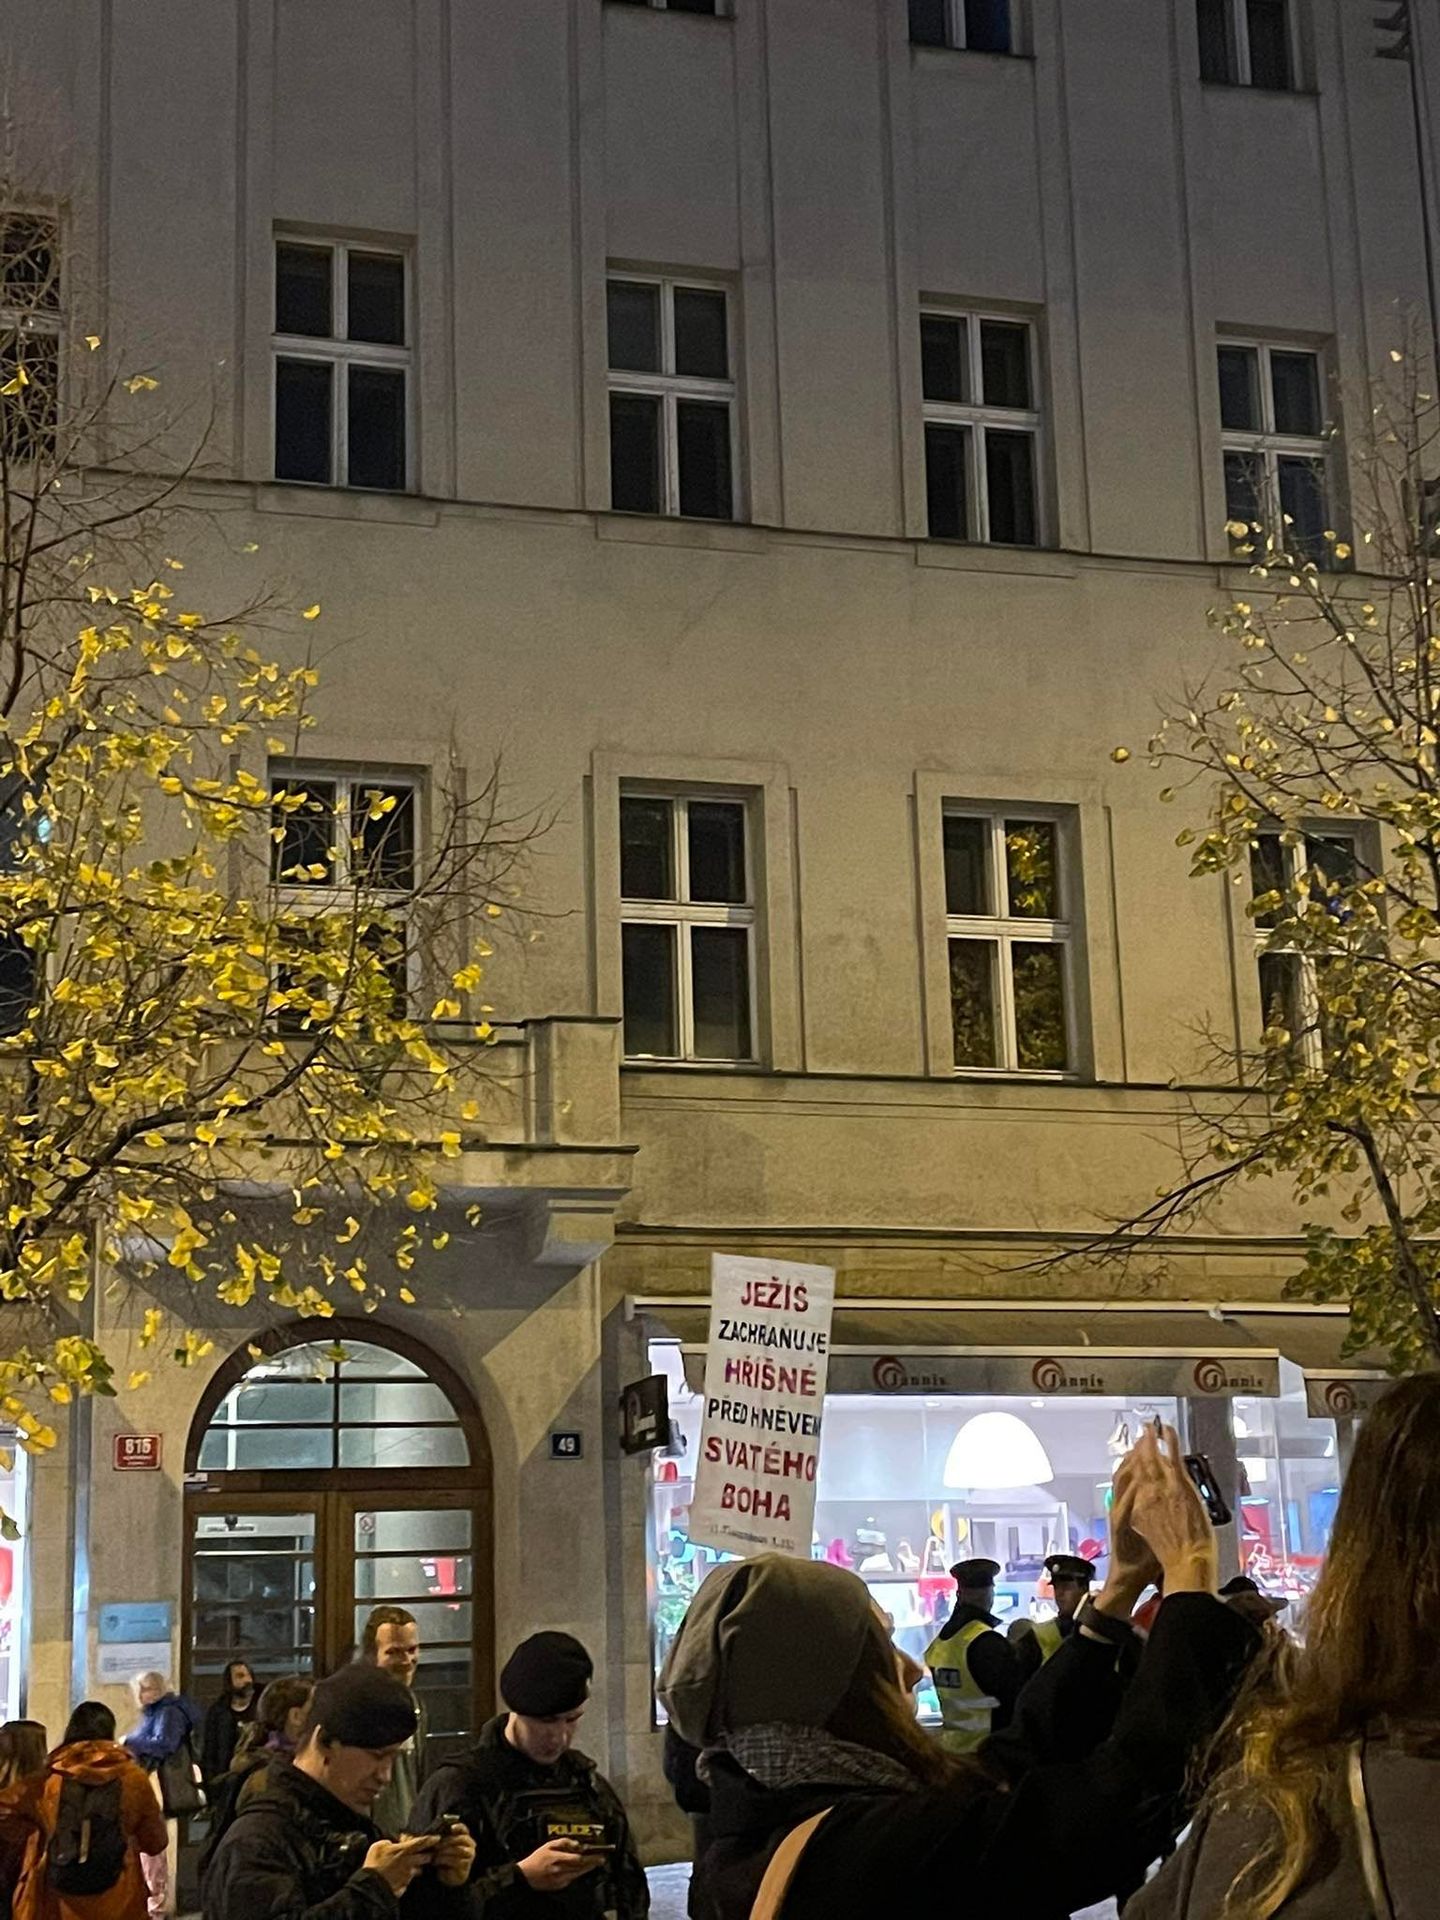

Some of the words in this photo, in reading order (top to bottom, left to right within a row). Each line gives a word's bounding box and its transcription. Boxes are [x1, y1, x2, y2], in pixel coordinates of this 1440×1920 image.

[558, 1437, 575, 1452] 49
[705, 1436, 818, 1482] SVATÉHO
[721, 1483, 791, 1521] BOHA
